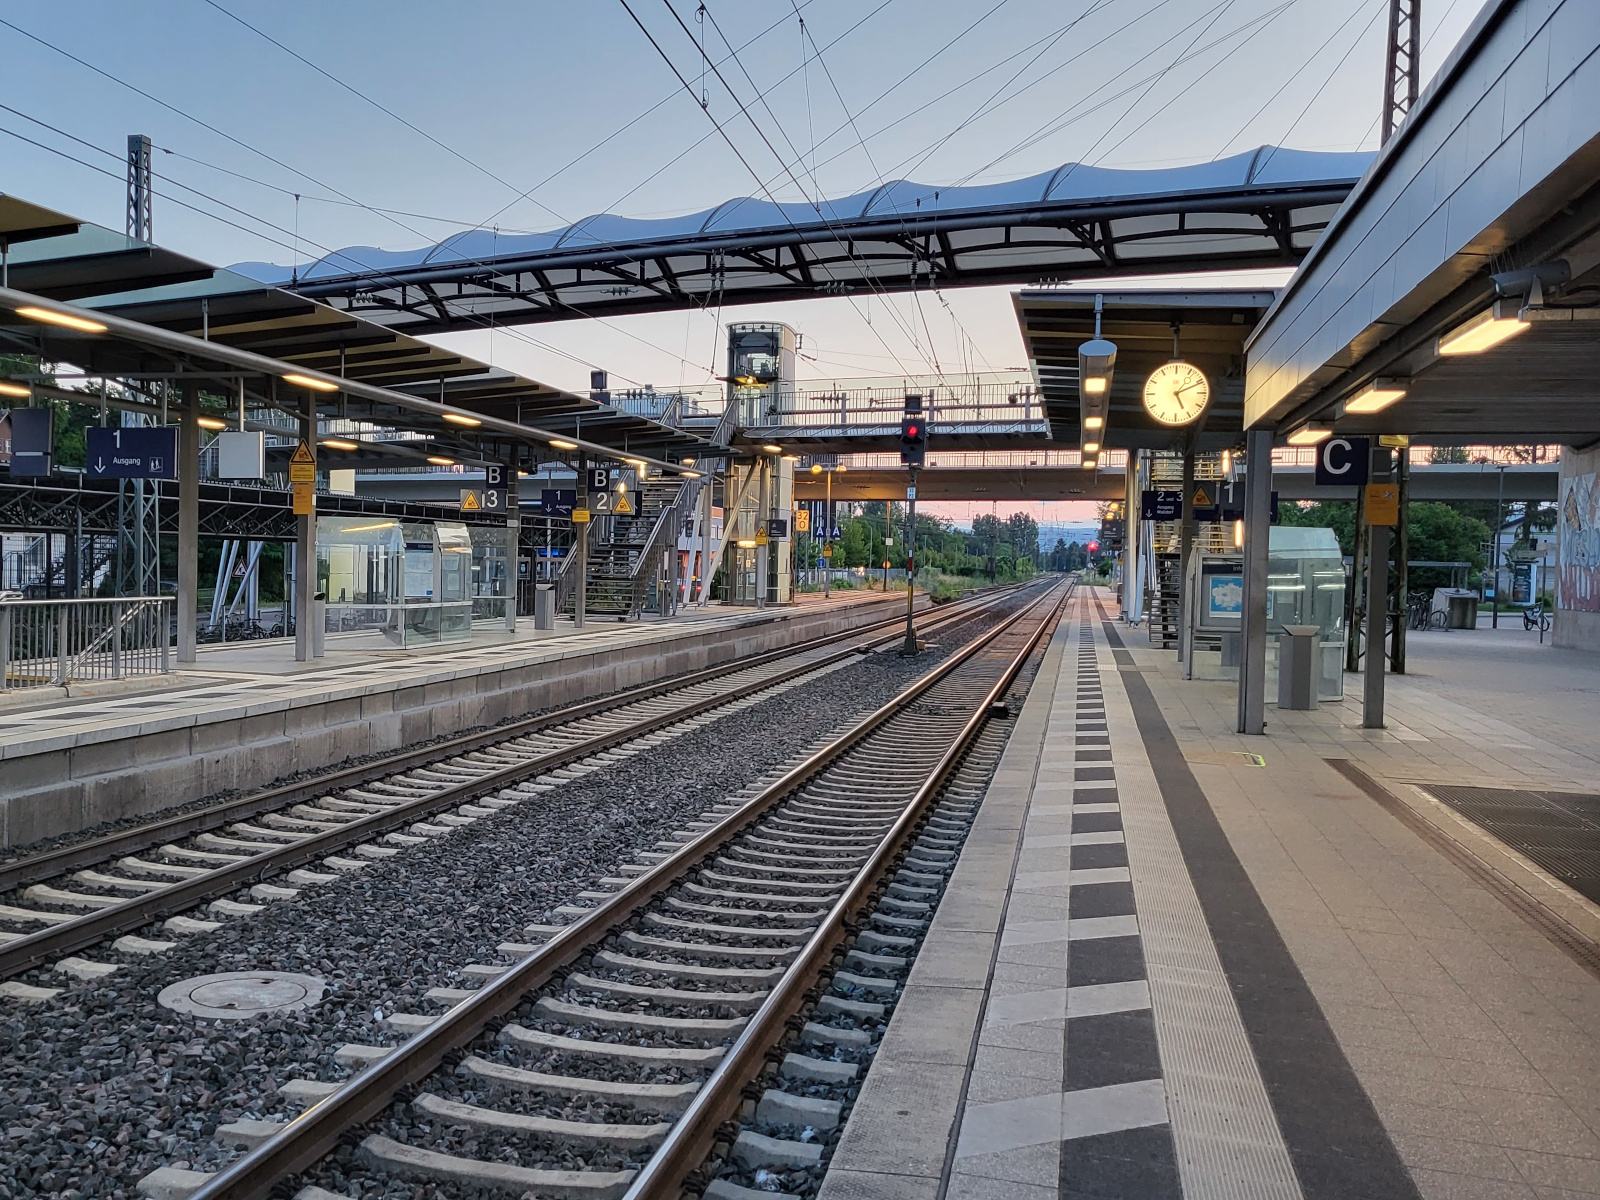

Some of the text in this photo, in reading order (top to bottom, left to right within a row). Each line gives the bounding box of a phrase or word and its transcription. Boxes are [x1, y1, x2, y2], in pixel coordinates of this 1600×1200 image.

[112, 429, 120, 449] 1
[112, 456, 141, 466] Ausgang
[1323, 439, 1352, 475] C
[488, 466, 500, 484] B
[594, 470, 606, 486] B
[486, 490, 498, 508] 3
[556, 490, 561, 500] 1
[596, 492, 608, 510] 2
[1156, 492, 1164, 502] 2
[1176, 492, 1184, 502] 3
[1224, 482, 1234, 504] 1
[797, 512, 809, 520] 32
[816, 526, 824, 536] A
[832, 526, 840, 536] A
